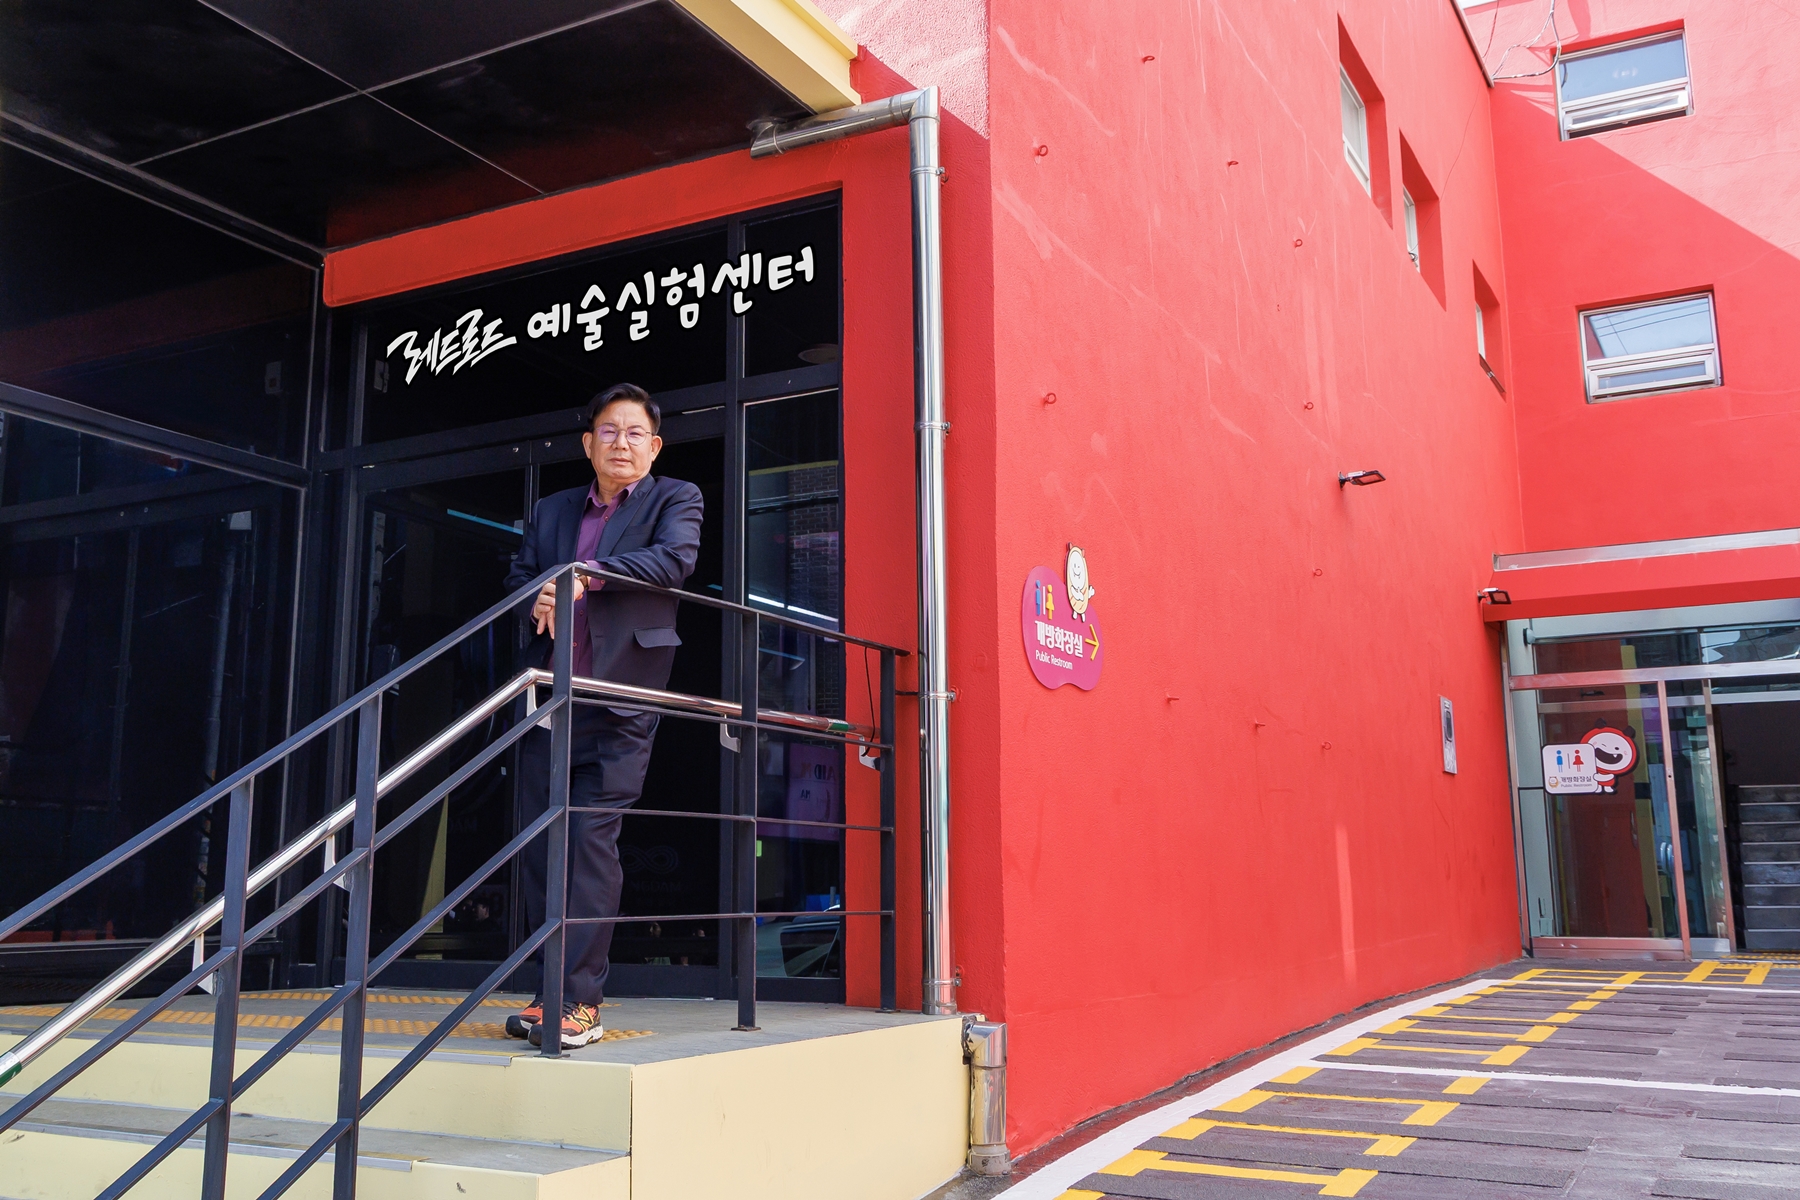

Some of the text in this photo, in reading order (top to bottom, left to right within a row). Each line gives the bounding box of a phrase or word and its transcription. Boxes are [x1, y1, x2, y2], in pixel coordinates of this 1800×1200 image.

[527, 246, 814, 351] 예술실험센터
[1035, 621, 1083, 658] 개방화장실
[1036, 650, 1072, 669] Public Restroom
